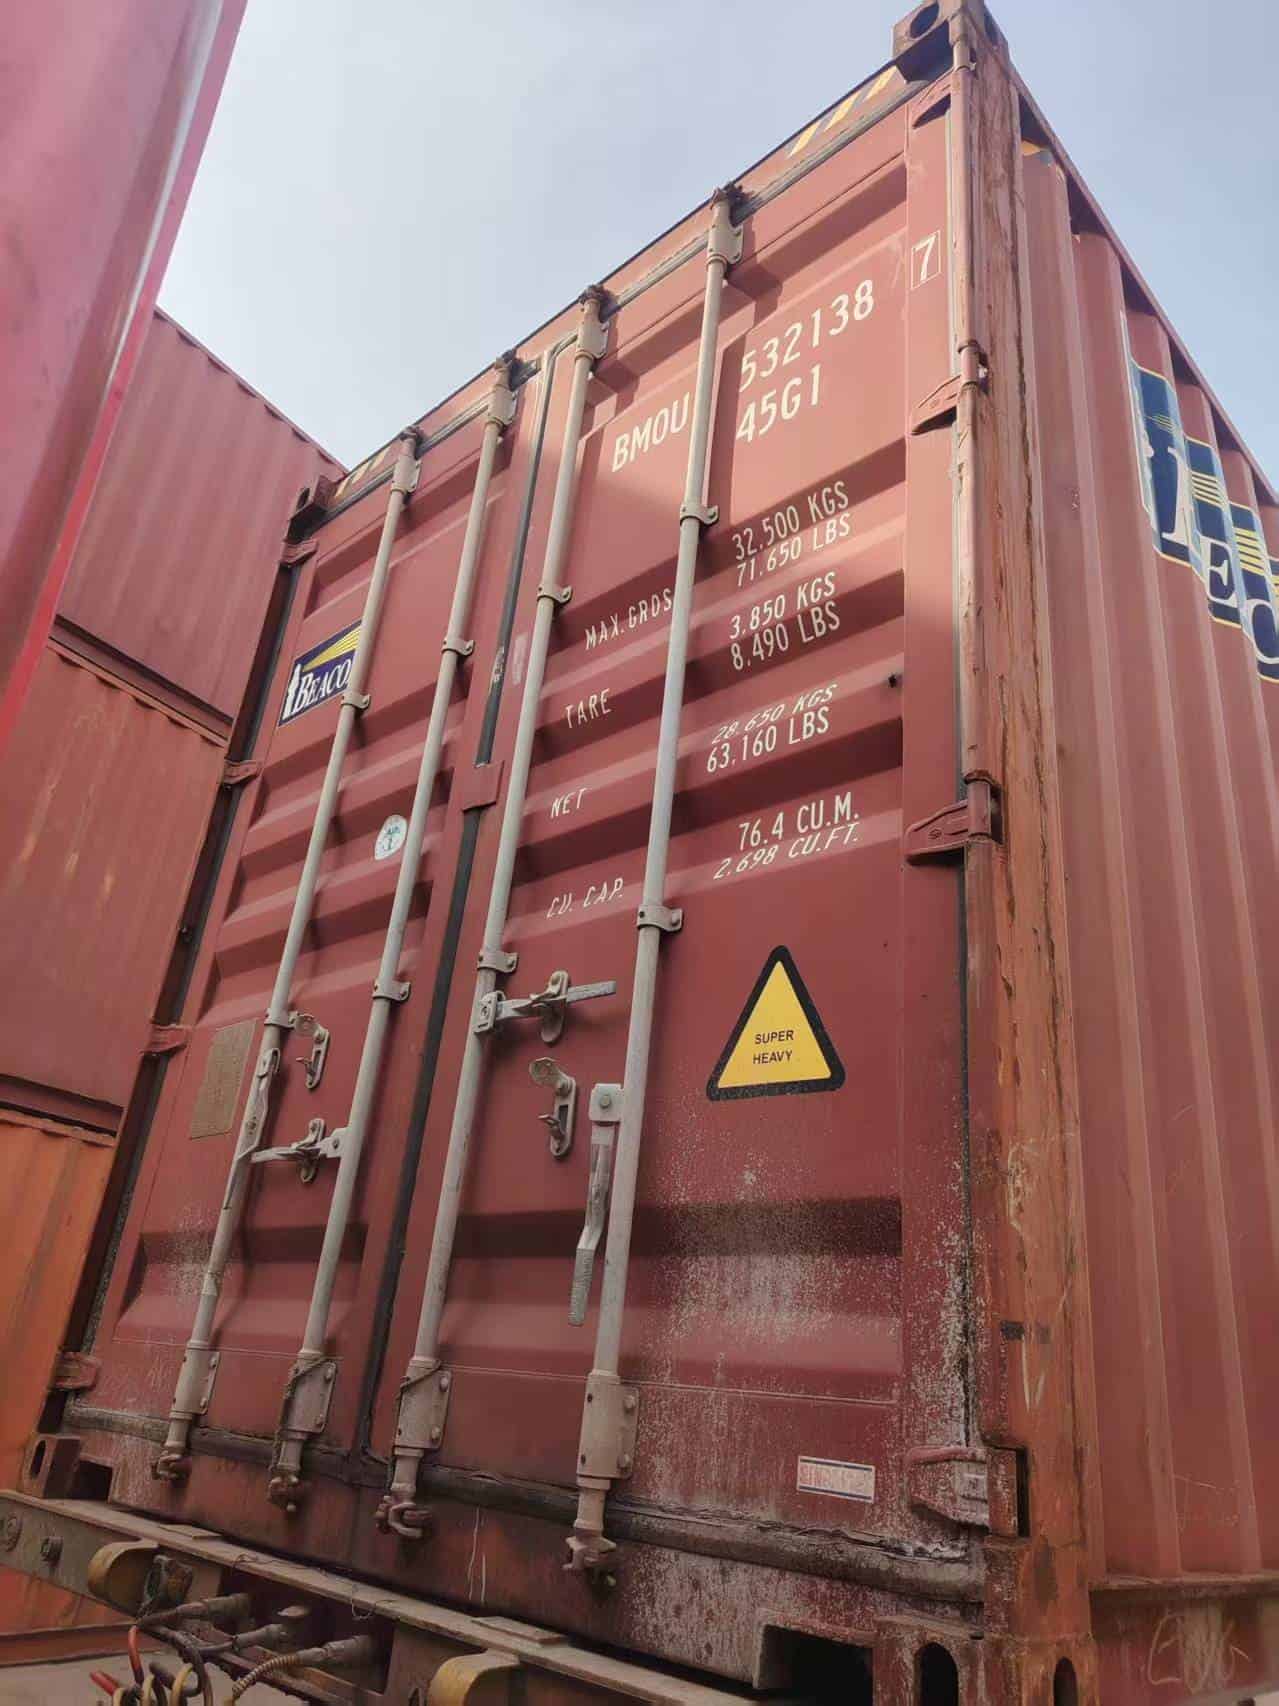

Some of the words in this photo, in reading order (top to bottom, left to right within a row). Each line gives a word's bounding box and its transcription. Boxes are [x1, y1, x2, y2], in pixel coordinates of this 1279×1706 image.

[611, 391, 691, 473] BMOU
[739, 279, 875, 393] 532138
[918, 234, 937, 282] 7
[735, 364, 821, 443] 45G1
[732, 505, 800, 560] 32.500
[808, 481, 849, 524] KGS
[737, 536, 801, 587] 71.650
[812, 512, 851, 551] LBS
[585, 588, 674, 651] MAX.GROS
[729, 595, 786, 640] 3.850
[796, 571, 836, 611] KGS
[731, 623, 789, 670] 8.490
[797, 600, 840, 643] LBS
[289, 658, 352, 715] BEACO
[565, 688, 613, 729] TARE
[711, 703, 786, 745] 28.650
[791, 683, 839, 714] KGS
[706, 725, 777, 773] 63.160
[788, 706, 830, 745] LBS
[550, 787, 593, 819] NET
[738, 811, 785, 852] 76.4
[796, 791, 860, 834] CU.M.
[713, 844, 780, 880] 2.698
[788, 821, 860, 859] CU.FT.
[546, 892, 573, 919] CU.
[583, 877, 624, 908] CAP.
[752, 1050, 793, 1065] HEAVY
[754, 1029, 795, 1045] SUPER
